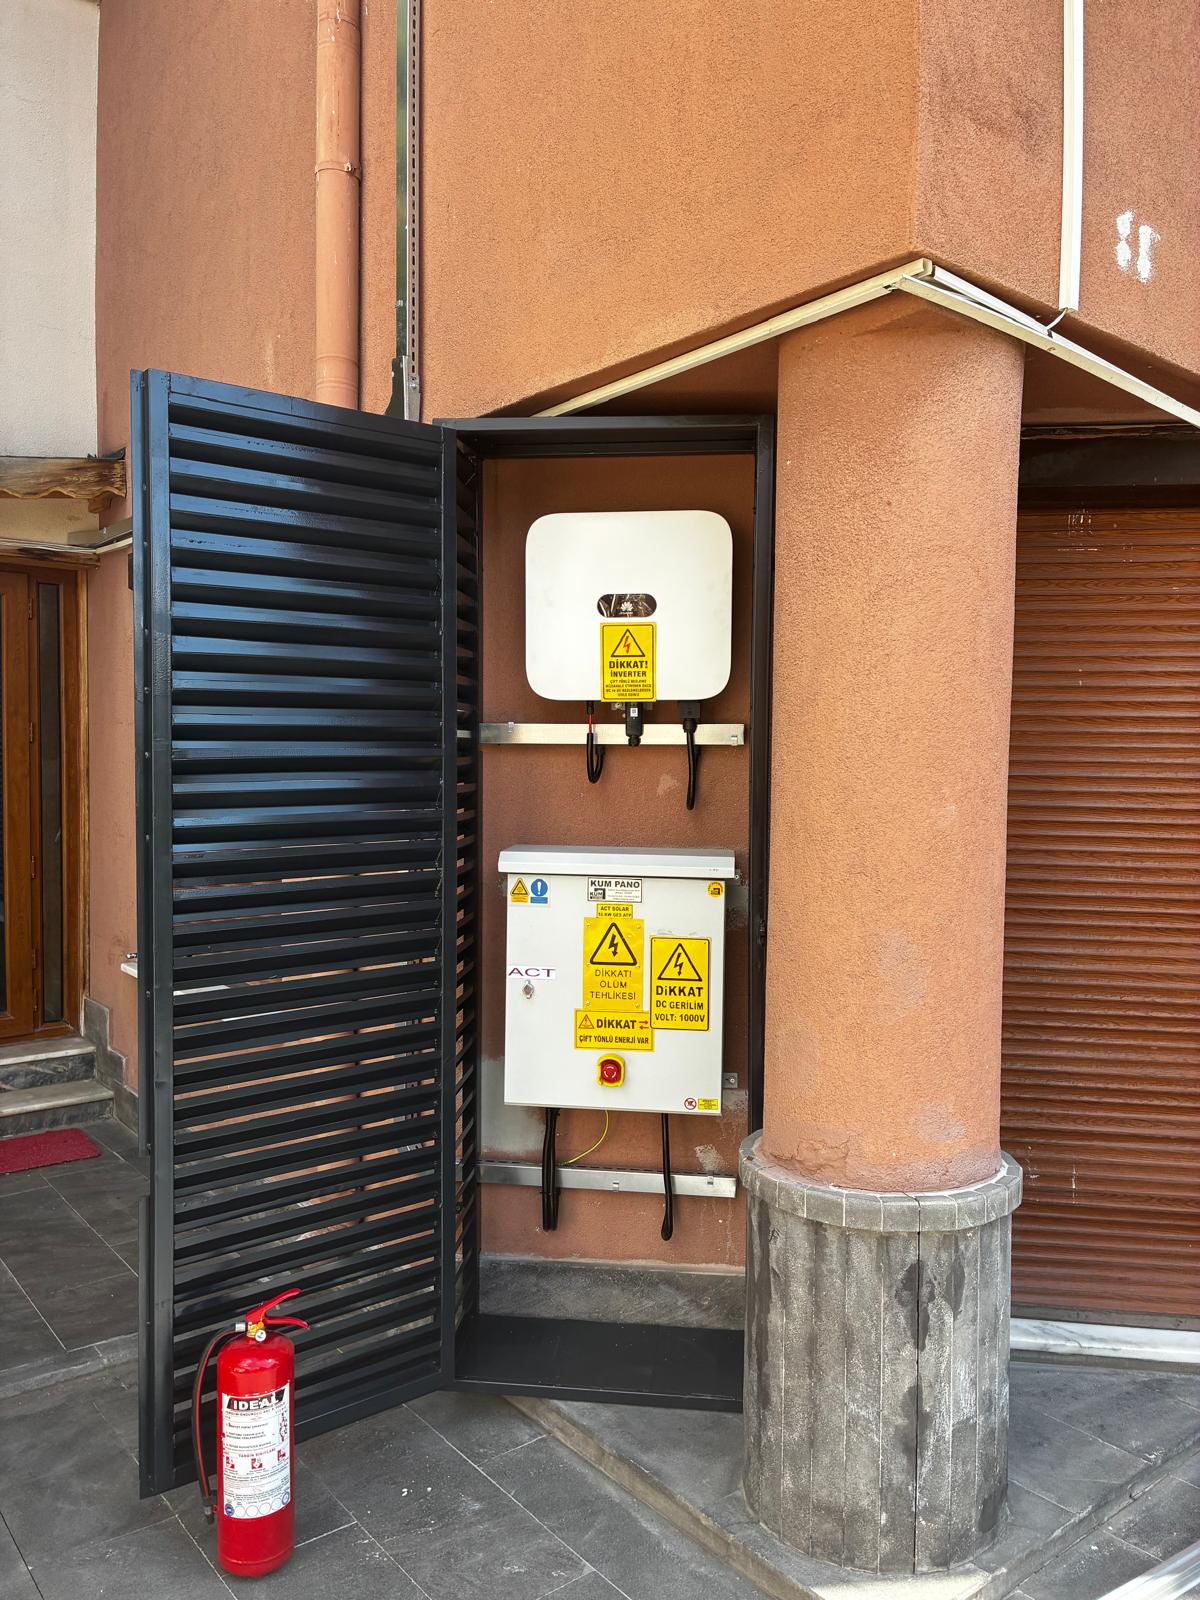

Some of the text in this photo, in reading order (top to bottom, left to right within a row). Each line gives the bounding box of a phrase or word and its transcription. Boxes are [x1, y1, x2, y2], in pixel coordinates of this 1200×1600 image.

[609, 659, 648, 669] DİKKAT!
[508, 967, 556, 977] ACT
[594, 969, 632, 978] DİKKAT!
[599, 980, 627, 989] ÖLÜM
[590, 991, 636, 1001] TEHLİKESİ
[656, 1000, 704, 1010] DC GERİLİM
[596, 1016, 637, 1029] DİKKAT
[655, 1013, 705, 1022] VOLT: 1000V
[579, 1035, 592, 1043] ÇİFT
[594, 1035, 614, 1043] YÖNLÜ
[614, 1035, 636, 1044] ENERJİ
[233, 1392, 281, 1410] IDEAL
